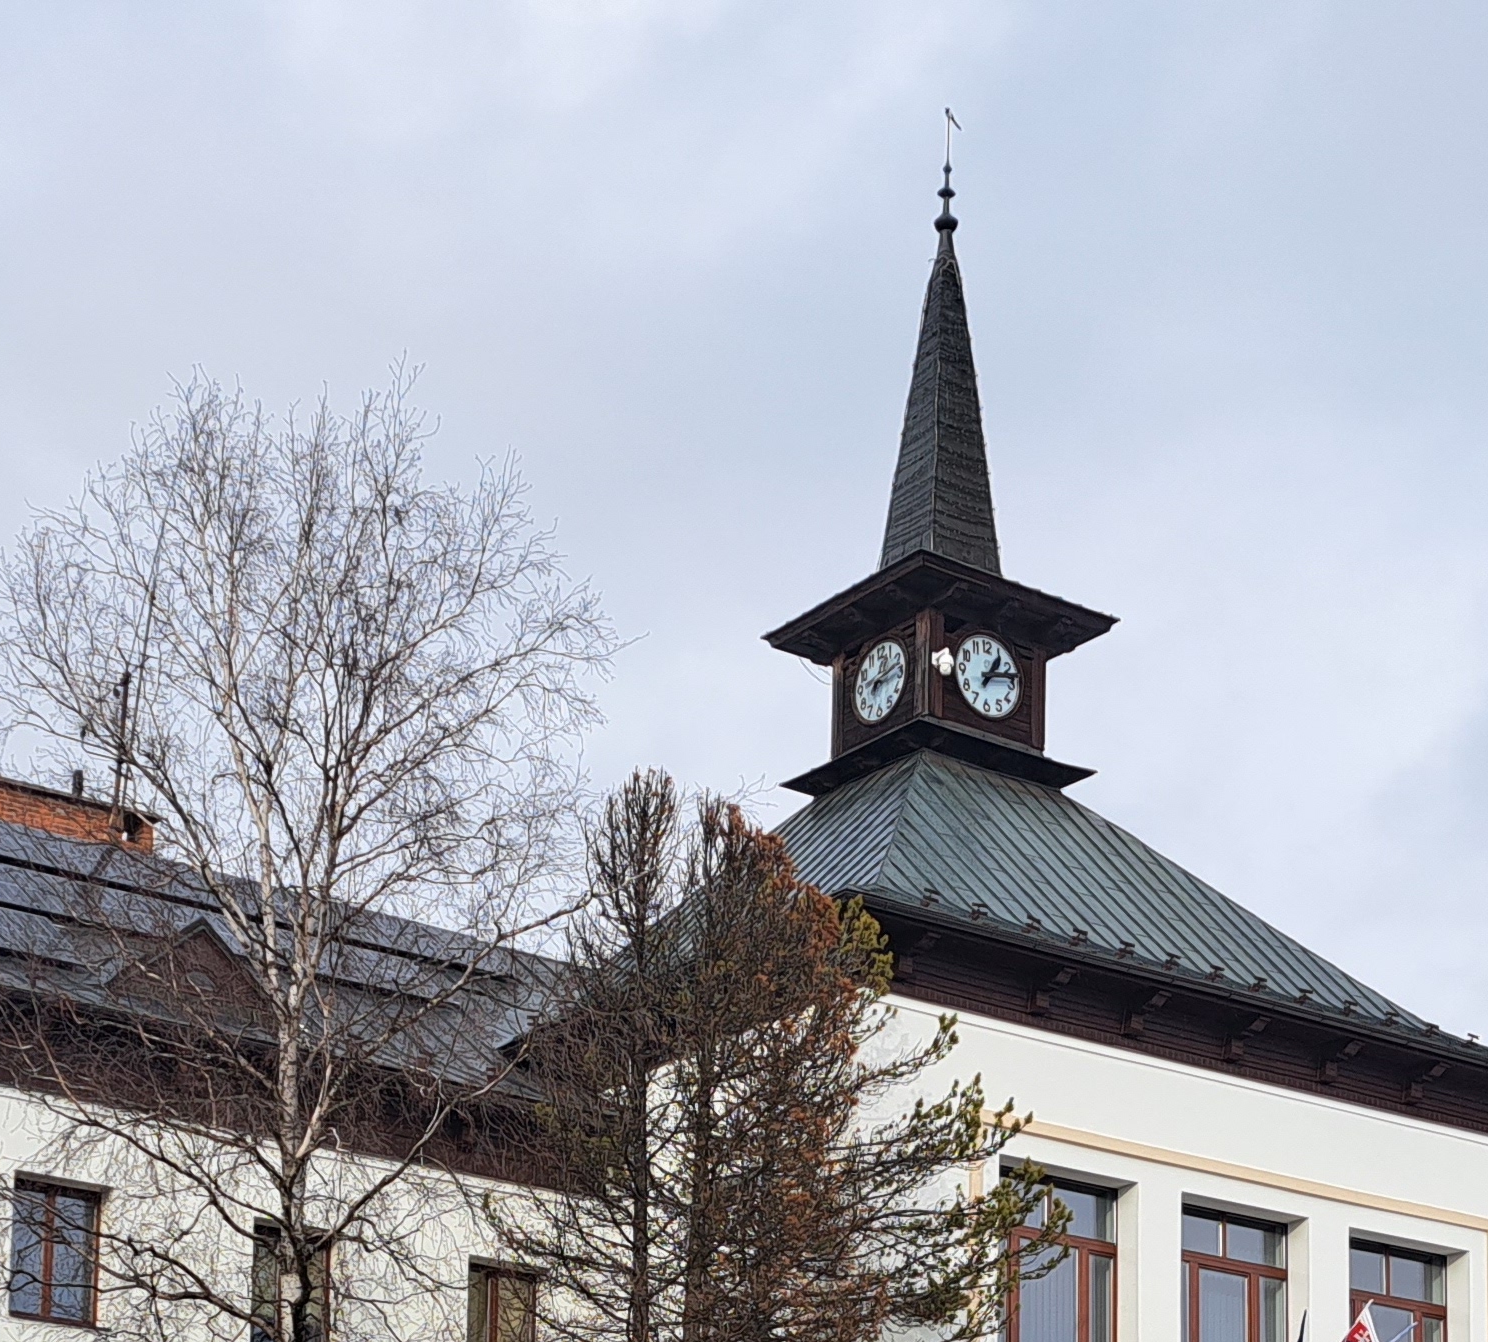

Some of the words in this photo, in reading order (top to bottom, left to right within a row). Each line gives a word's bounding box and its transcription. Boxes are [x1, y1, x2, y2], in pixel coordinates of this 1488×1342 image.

[877, 645, 885, 660] 12
[889, 644, 892, 659] 1
[973, 639, 979, 655] 11
[982, 639, 992, 656] 12
[868, 653, 874, 669] 11
[894, 652, 900, 665] 2
[962, 648, 970, 662] 10
[897, 664, 903, 679] 3
[959, 662, 966, 676] 9
[1004, 661, 1011, 674] 2
[857, 685, 863, 698] 9
[893, 680, 900, 694] 4
[963, 678, 970, 691] 8
[860, 697, 866, 711] 8
[886, 695, 893, 709] 5
[972, 690, 979, 704] 7
[1004, 691, 1012, 704] 4
[867, 703, 873, 718] 7
[876, 703, 883, 717] 6
[983, 698, 990, 712] 6
[995, 698, 1002, 712] 5
